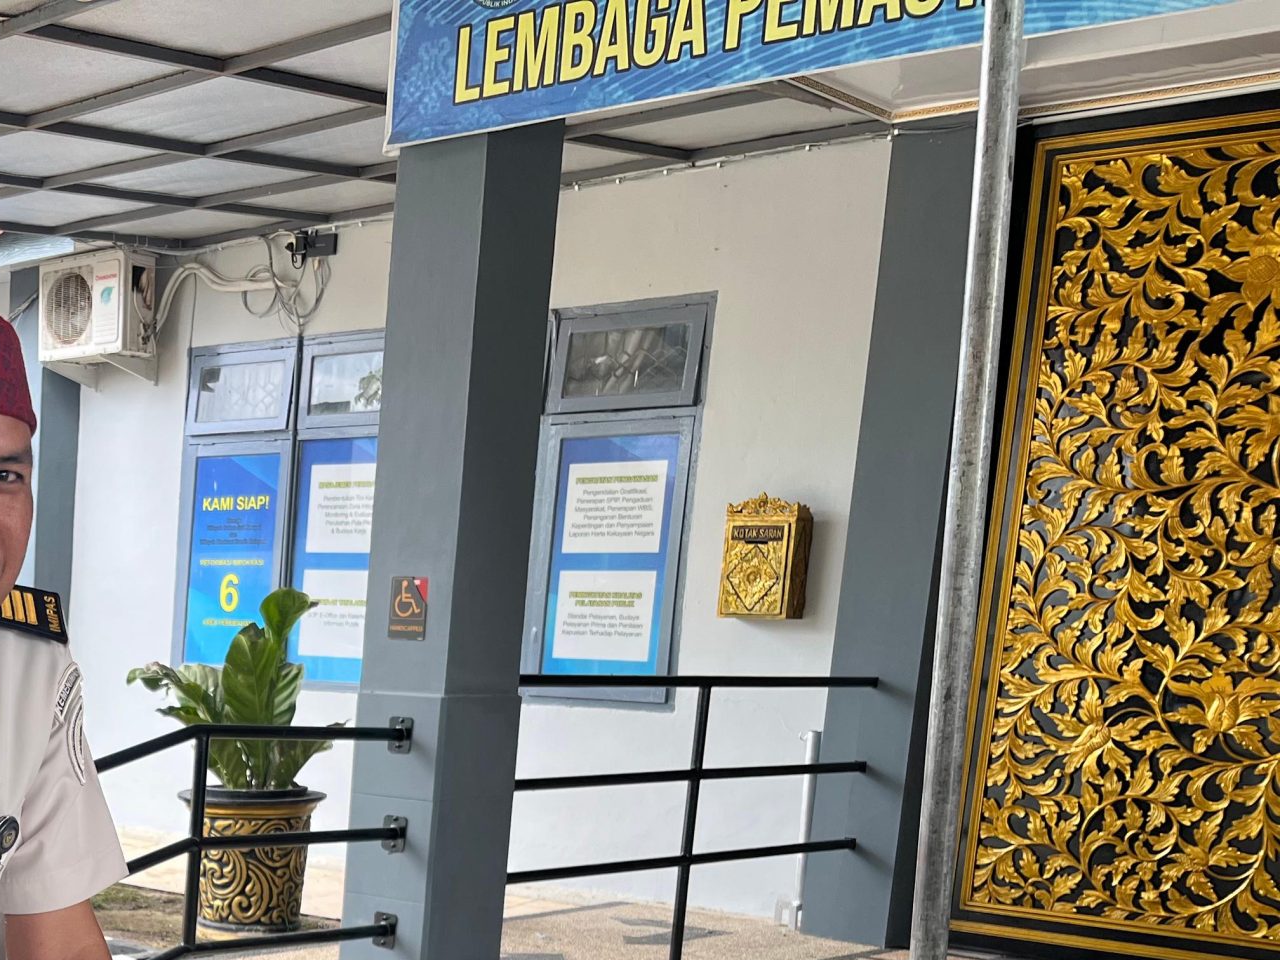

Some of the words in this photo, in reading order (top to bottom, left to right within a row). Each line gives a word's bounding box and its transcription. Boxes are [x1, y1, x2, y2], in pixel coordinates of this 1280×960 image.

[453, 0, 706, 105] LEMBAGA
[202, 496, 234, 511] KAMI
[236, 495, 270, 511] SIAP!
[733, 528, 758, 538] KOTAK
[759, 528, 783, 539] SARAN
[219, 572, 240, 613] 6
[44, 595, 62, 633] IMIPAS
